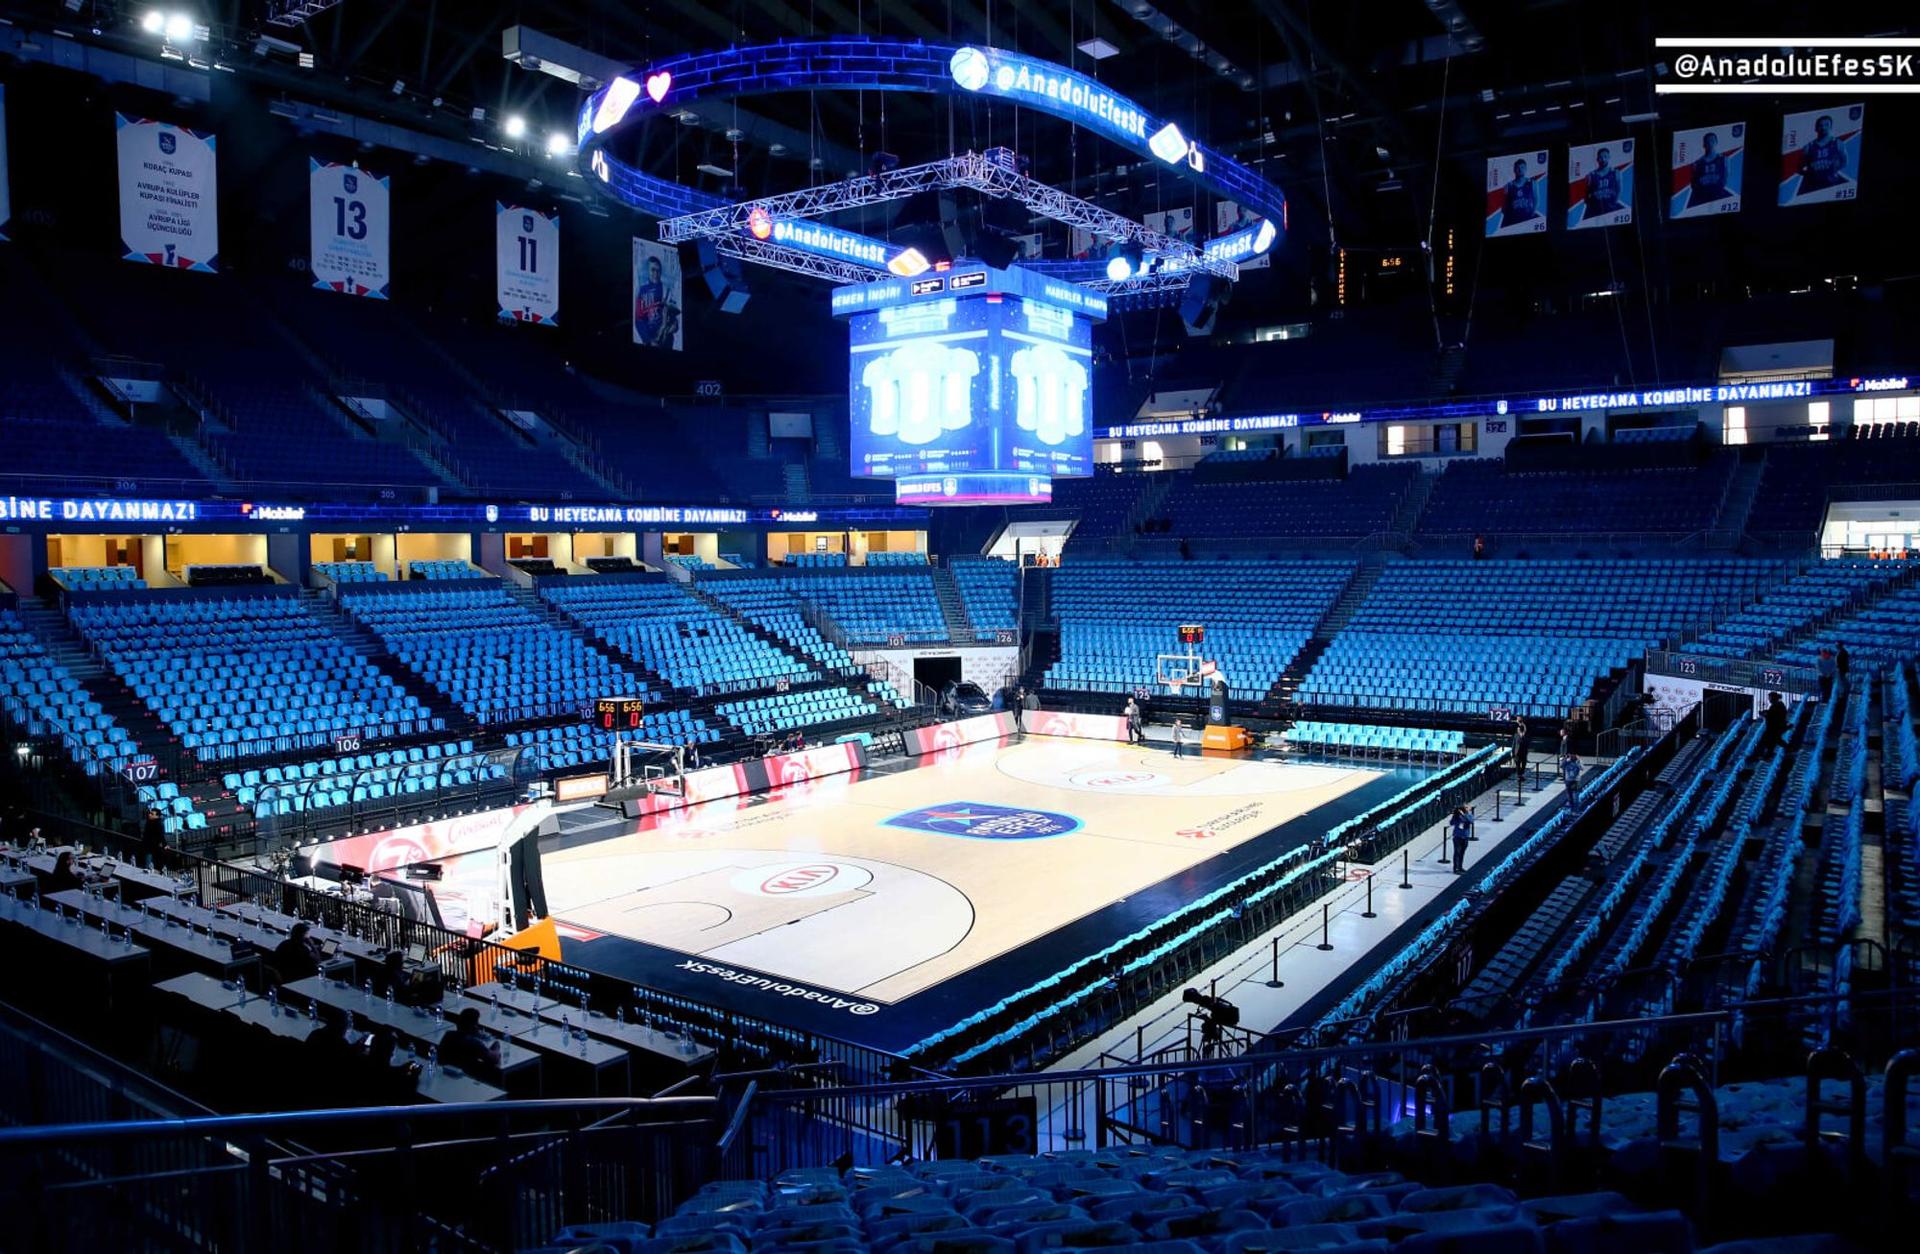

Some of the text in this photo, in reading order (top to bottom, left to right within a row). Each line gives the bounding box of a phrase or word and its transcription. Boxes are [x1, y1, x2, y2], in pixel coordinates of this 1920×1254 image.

[997, 66, 1147, 138] @AnadoluEfesSK
[137, 182, 165, 193] AVRUPA
[1835, 188, 1855, 199] #15
[1720, 202, 1739, 212] #12
[149, 213, 176, 225] AVRUPA
[334, 196, 367, 240] 13
[1614, 214, 1631, 224] #10
[774, 222, 886, 263] @AnadoluEfesSK
[518, 236, 537, 273] 11
[696, 383, 721, 396] 402
[1864, 377, 1908, 391] Mobilet
[1538, 382, 1811, 412] BU HEYECANA KOMBİNE DAYANMAZ!
[1109, 415, 1298, 438] BU HEYECANA KOMBİNE DAYANMAZ!
[63, 502, 195, 520] DAYANMAZ!
[258, 506, 305, 519] Mobilet
[530, 506, 747, 523] BU HEYECANA KOMBİNE DAYANMAZ!
[889, 637, 905, 646] 101
[996, 634, 1012, 643] 126
[1680, 662, 1696, 674] 123
[1763, 672, 1782, 684] 122
[776, 682, 790, 692] 104
[604, 712, 639, 728] 0 0
[1490, 711, 1510, 721] 124
[336, 738, 360, 752] 106
[126, 765, 157, 780] 107
[772, 869, 831, 889] KIA
[675, 959, 881, 1015] @AnadoluEfesSK
[945, 1113, 1032, 1158] 113
